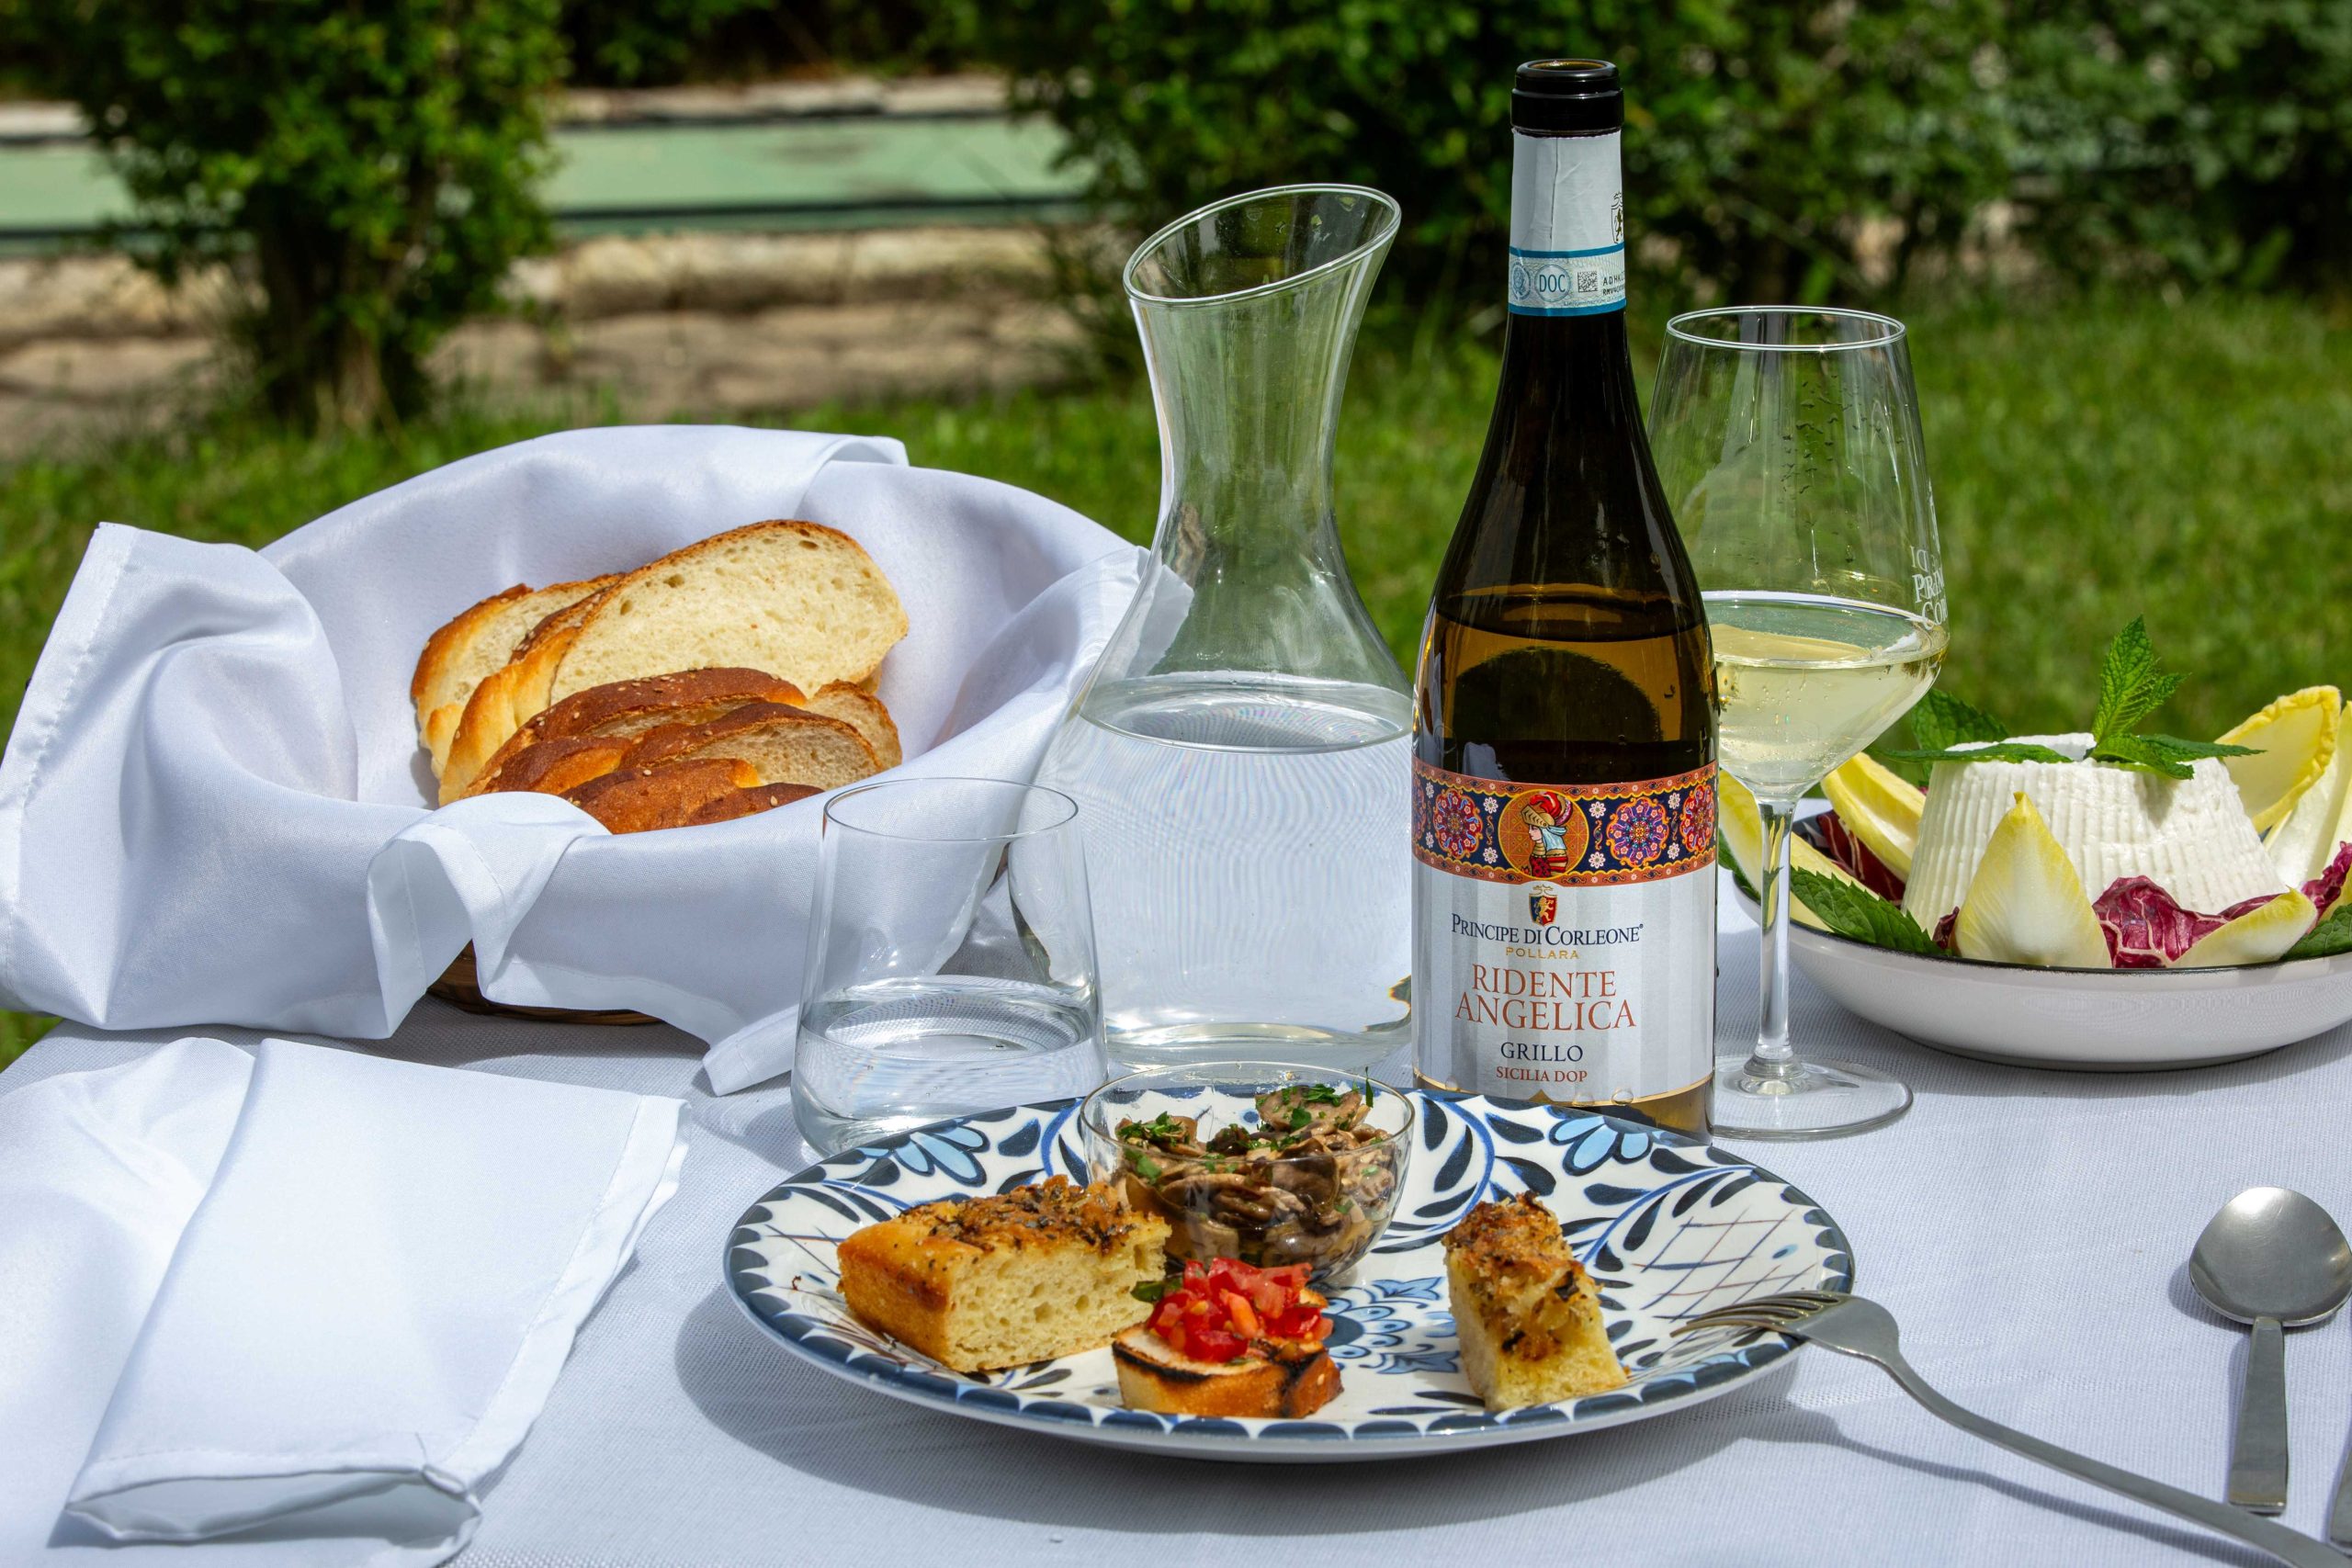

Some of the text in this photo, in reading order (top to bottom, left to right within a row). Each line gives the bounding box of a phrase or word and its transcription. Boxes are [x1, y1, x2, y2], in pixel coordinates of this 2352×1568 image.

[1539, 274, 1566, 293] DOC
[1451, 913, 1520, 944] PRINCIPE
[1524, 929, 1542, 945] DI
[1506, 946, 1579, 960] POLLARA
[1472, 963, 1617, 998] RIDENTE
[1454, 991, 1636, 1031] ANGELICA
[1500, 1042, 1584, 1062] GRILLO
[1496, 1066, 1588, 1083] SICILIA DOP
